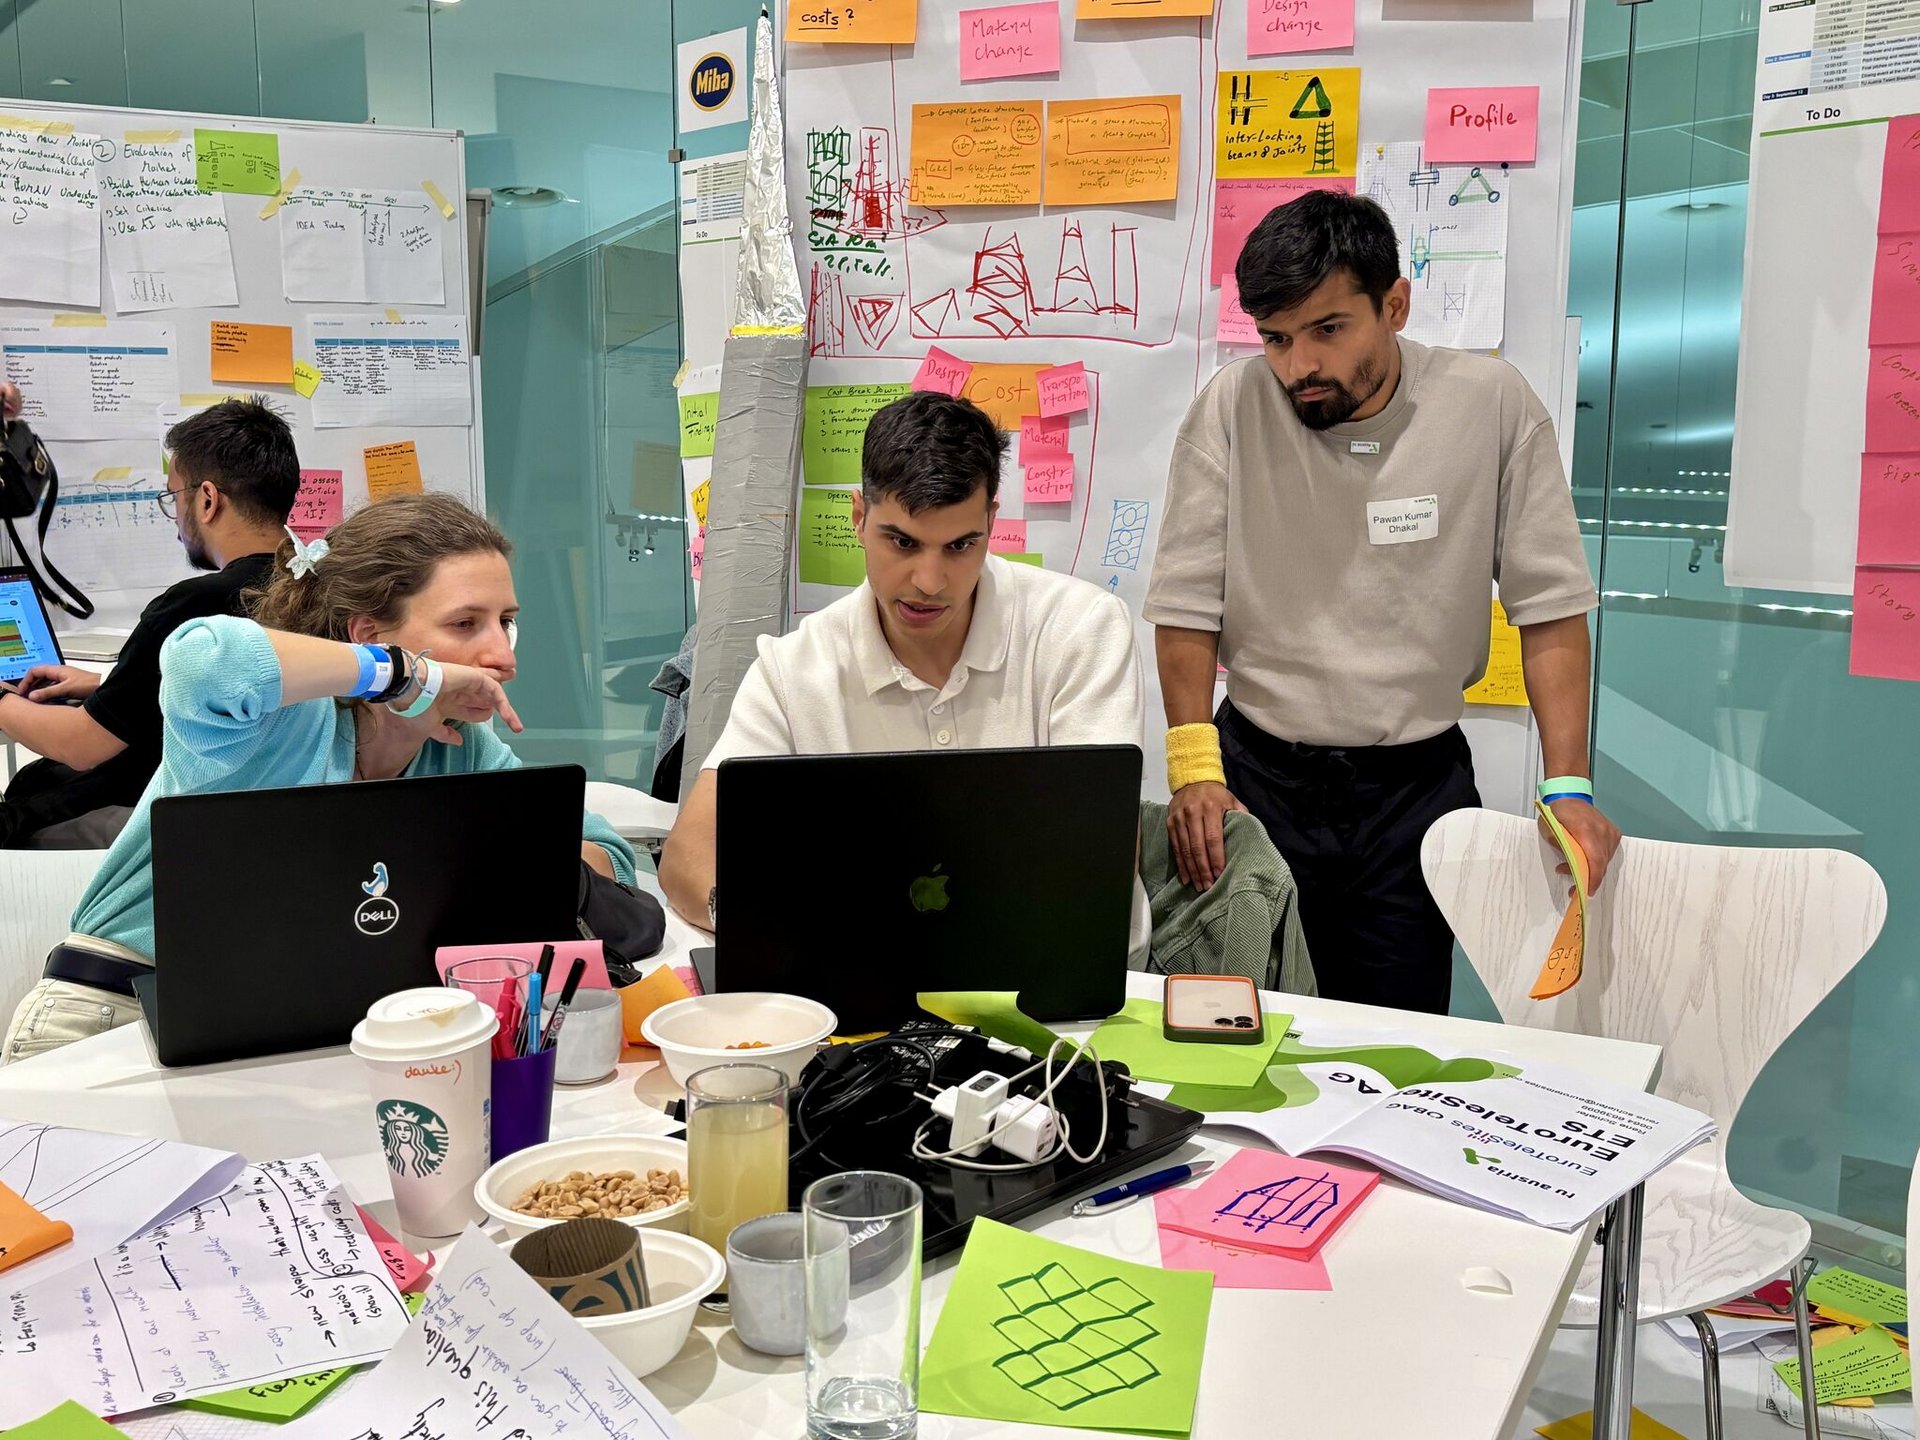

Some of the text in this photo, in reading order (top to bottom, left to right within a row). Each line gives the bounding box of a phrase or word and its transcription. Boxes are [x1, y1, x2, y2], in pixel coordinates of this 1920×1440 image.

[801, 8, 855, 26] costs ?
[1262, 0, 1308, 16] Design
[972, 18, 1032, 38] Material
[1266, 18, 1323, 36] change
[975, 43, 1033, 62] change
[696, 67, 730, 96] Miba
[1450, 104, 1517, 131] Profile
[1806, 108, 1841, 120] To Do
[124, 143, 173, 158] Evaluation
[114, 205, 129, 216] Set
[118, 221, 137, 234] Use
[926, 359, 965, 387] Design
[968, 377, 1030, 404] Cost
[1024, 428, 1065, 448] Material
[1027, 481, 1073, 494] uction
[1373, 511, 1432, 524] Pawan Kumar
[1389, 523, 1418, 533] Dhakal
[360, 910, 395, 923] DELL
[1328, 1072, 1620, 1162] EuroTeleSite AG
[1562, 1120, 1637, 1149] ETS
[1451, 1119, 1598, 1177] EuroTeleSites
[328, 1285, 361, 1325] materials
[308, 1305, 328, 1327] new
[498, 1307, 517, 1328] up
[606, 1379, 634, 1411] Hive
